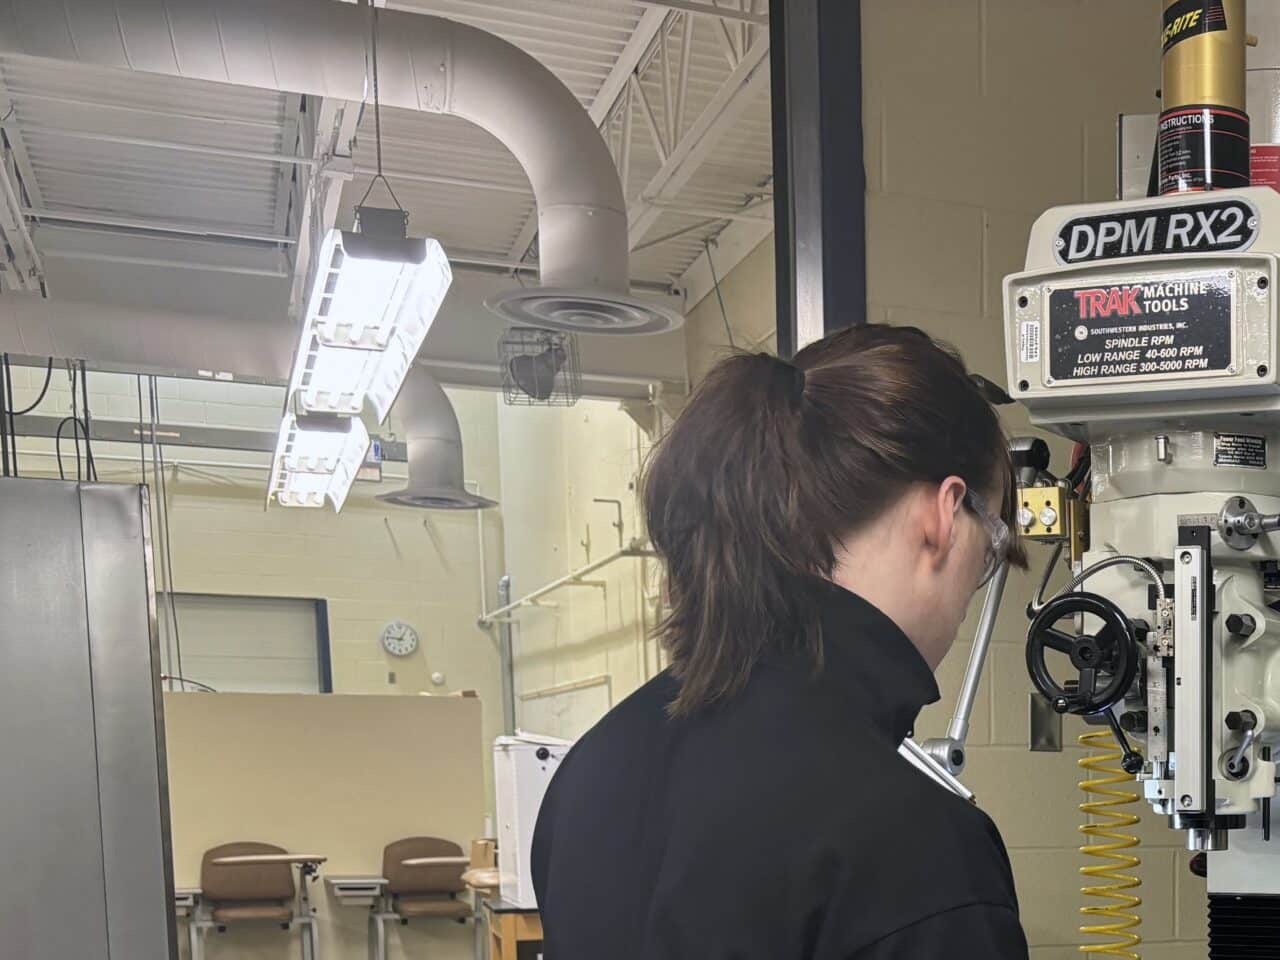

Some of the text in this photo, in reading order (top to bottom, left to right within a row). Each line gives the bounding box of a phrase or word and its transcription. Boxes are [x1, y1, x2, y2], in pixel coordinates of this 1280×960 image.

[1161, 8, 1203, 48] E-RITE
[1067, 207, 1244, 260] DPM RX2
[1073, 281, 1208, 320] TRAK MACHINE
[1143, 298, 1189, 314] TOOLS
[1090, 325, 1137, 336] SOUTHWESTERN
[1105, 334, 1175, 350] SPINDLE RPM
[1077, 345, 1204, 364] LOW RANGE 40-600 RPM
[1073, 358, 1209, 377] HIGH RANGE 300-5000 RPM
